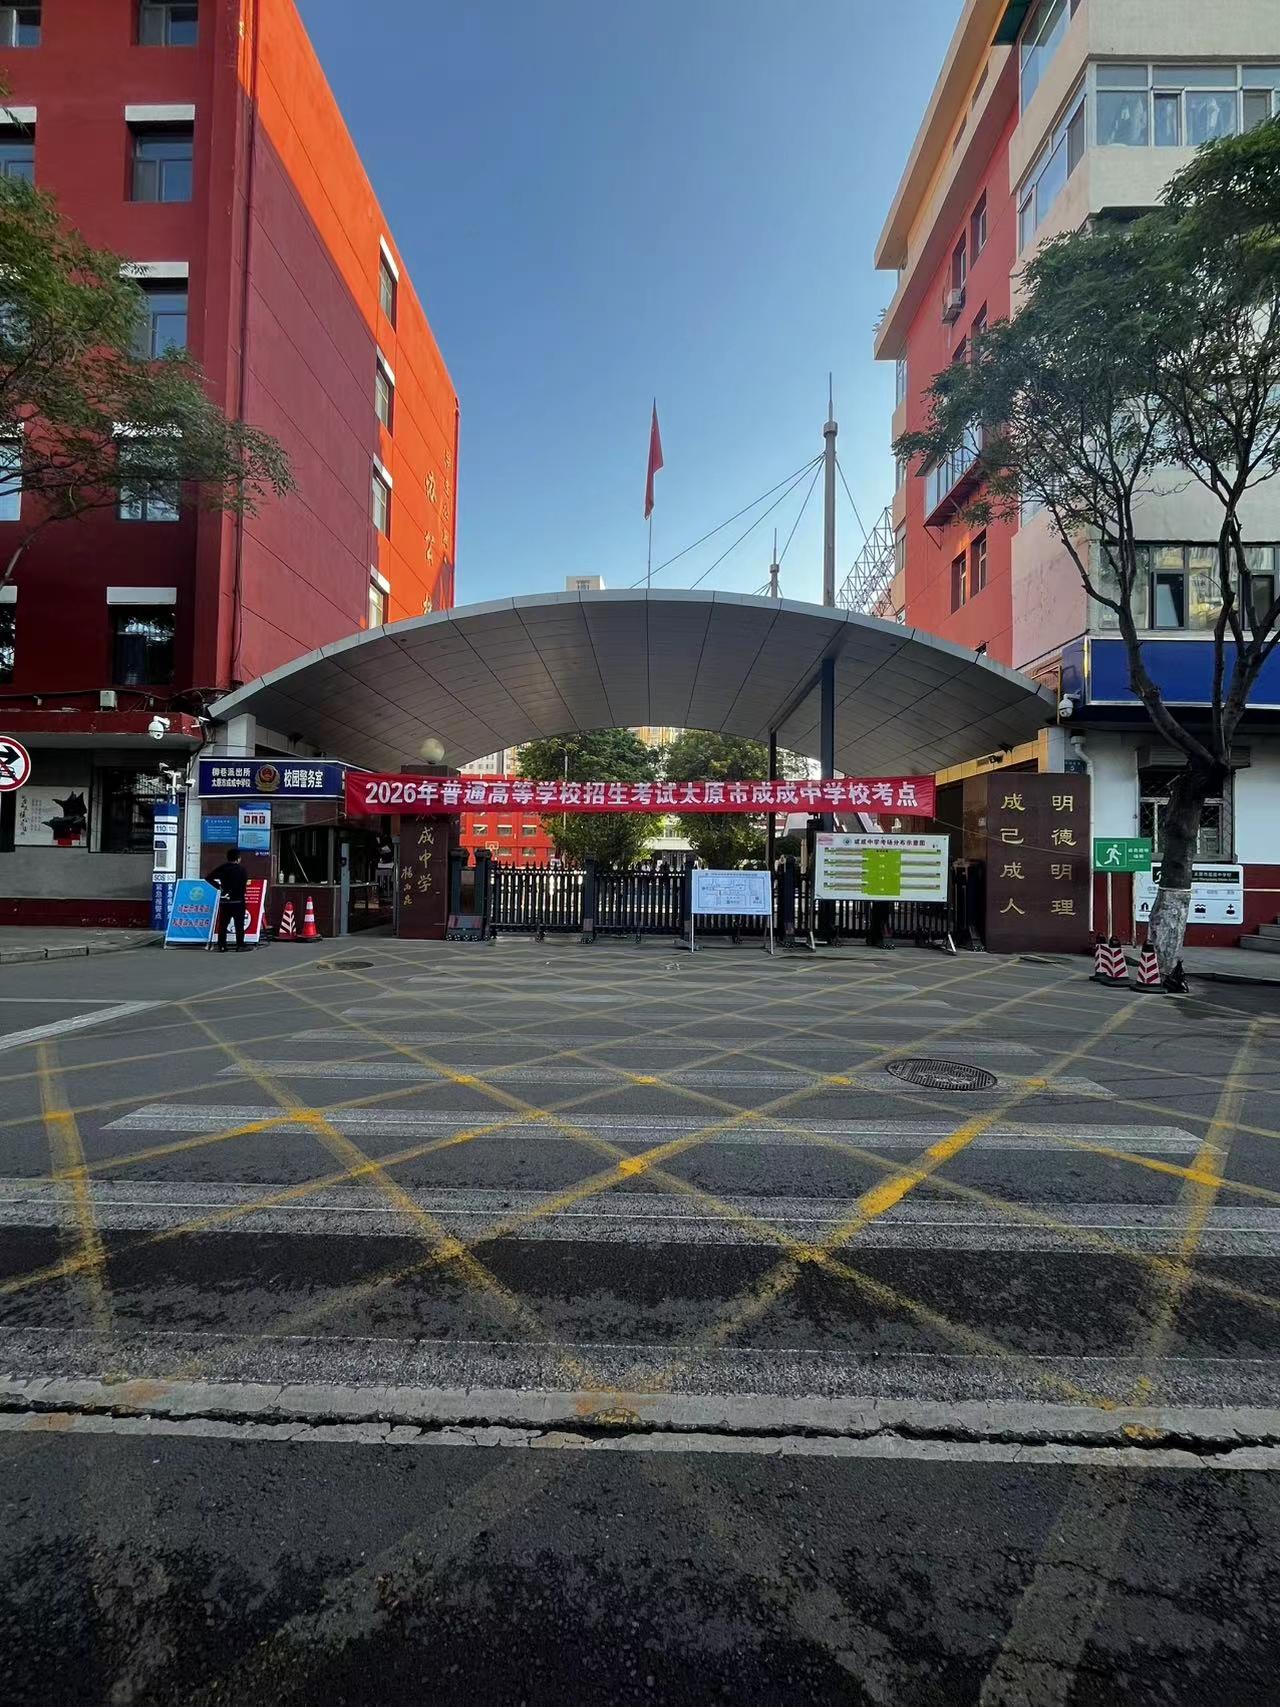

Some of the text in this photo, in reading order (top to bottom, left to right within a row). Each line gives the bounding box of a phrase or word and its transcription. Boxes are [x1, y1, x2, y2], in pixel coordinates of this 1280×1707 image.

[284, 769, 323, 788] 校园警务室
[365, 780, 919, 807] 2026年普通高等学校招生考试太原市成成中学校考点
[155, 824, 167, 832] 110
[416, 814, 434, 893] 成中学
[1000, 793, 1025, 914] 成己成人
[1050, 795, 1077, 916] 明德明理
[154, 873, 166, 881] SOS
